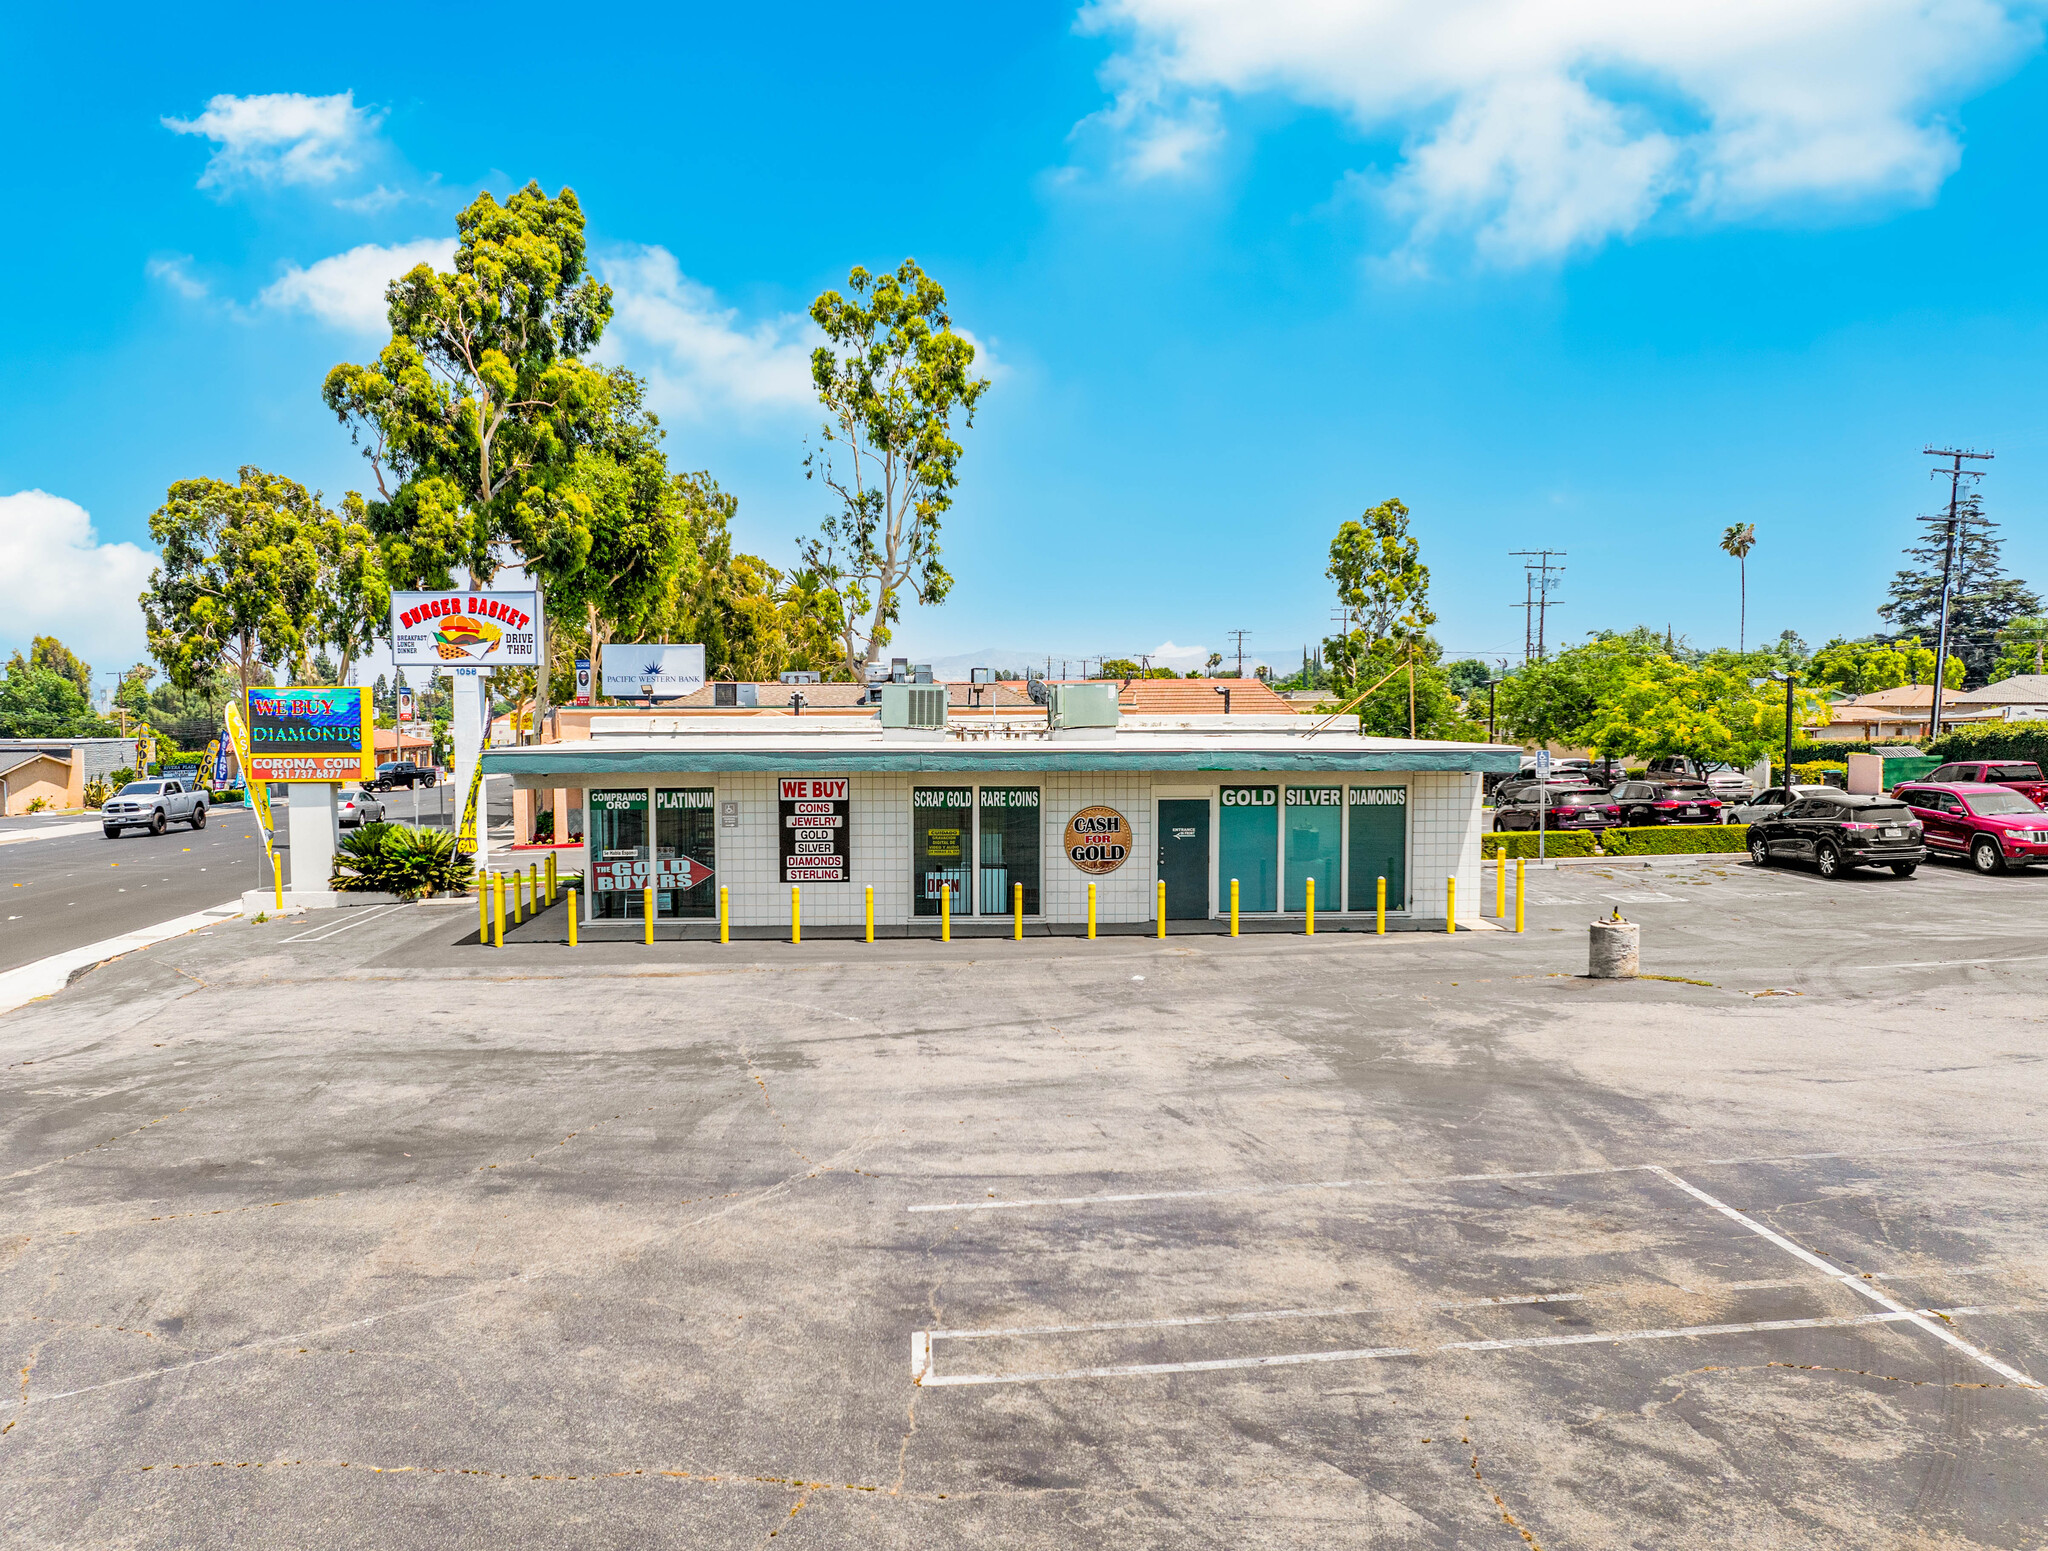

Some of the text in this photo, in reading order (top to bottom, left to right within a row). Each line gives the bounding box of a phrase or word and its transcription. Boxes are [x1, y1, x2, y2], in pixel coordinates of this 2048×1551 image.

[400, 597, 531, 630] BURGER BASKET
[397, 634, 427, 642] BREAKFAST
[506, 633, 533, 643] DRIVE
[507, 644, 532, 655] THRU
[456, 668, 477, 676] 1058
[607, 675, 700, 683] PACIFIC WESTERN BANK
[254, 698, 334, 716] WE BUY
[253, 727, 361, 742] DIAMONDS
[219, 733, 229, 779] NOTARY
[252, 758, 360, 769] CORONA COIN
[271, 769, 342, 779] 951.737.6877
[783, 782, 845, 798] WE BUY
[592, 793, 647, 802] COMPRAMOS
[657, 792, 714, 809] PLATINUM
[914, 791, 972, 807] SCRAP GOLD
[981, 791, 1038, 807] RARE COINS
[1222, 789, 1275, 806] GOLD
[1286, 789, 1341, 806] SILVER
[1349, 789, 1405, 806] DIAMONDS
[606, 801, 630, 810] ORO
[798, 804, 830, 813] COINS
[791, 817, 837, 826] JEWELRY
[1074, 816, 1120, 833] CASH
[801, 830, 828, 840] GOLD
[1085, 835, 1110, 844] FOR
[798, 843, 831, 853] SILVER
[1071, 845, 1125, 862] GOLD
[788, 856, 841, 866] DIAMONDS
[612, 860, 690, 876] GOLD
[790, 869, 839, 879] STERLING
